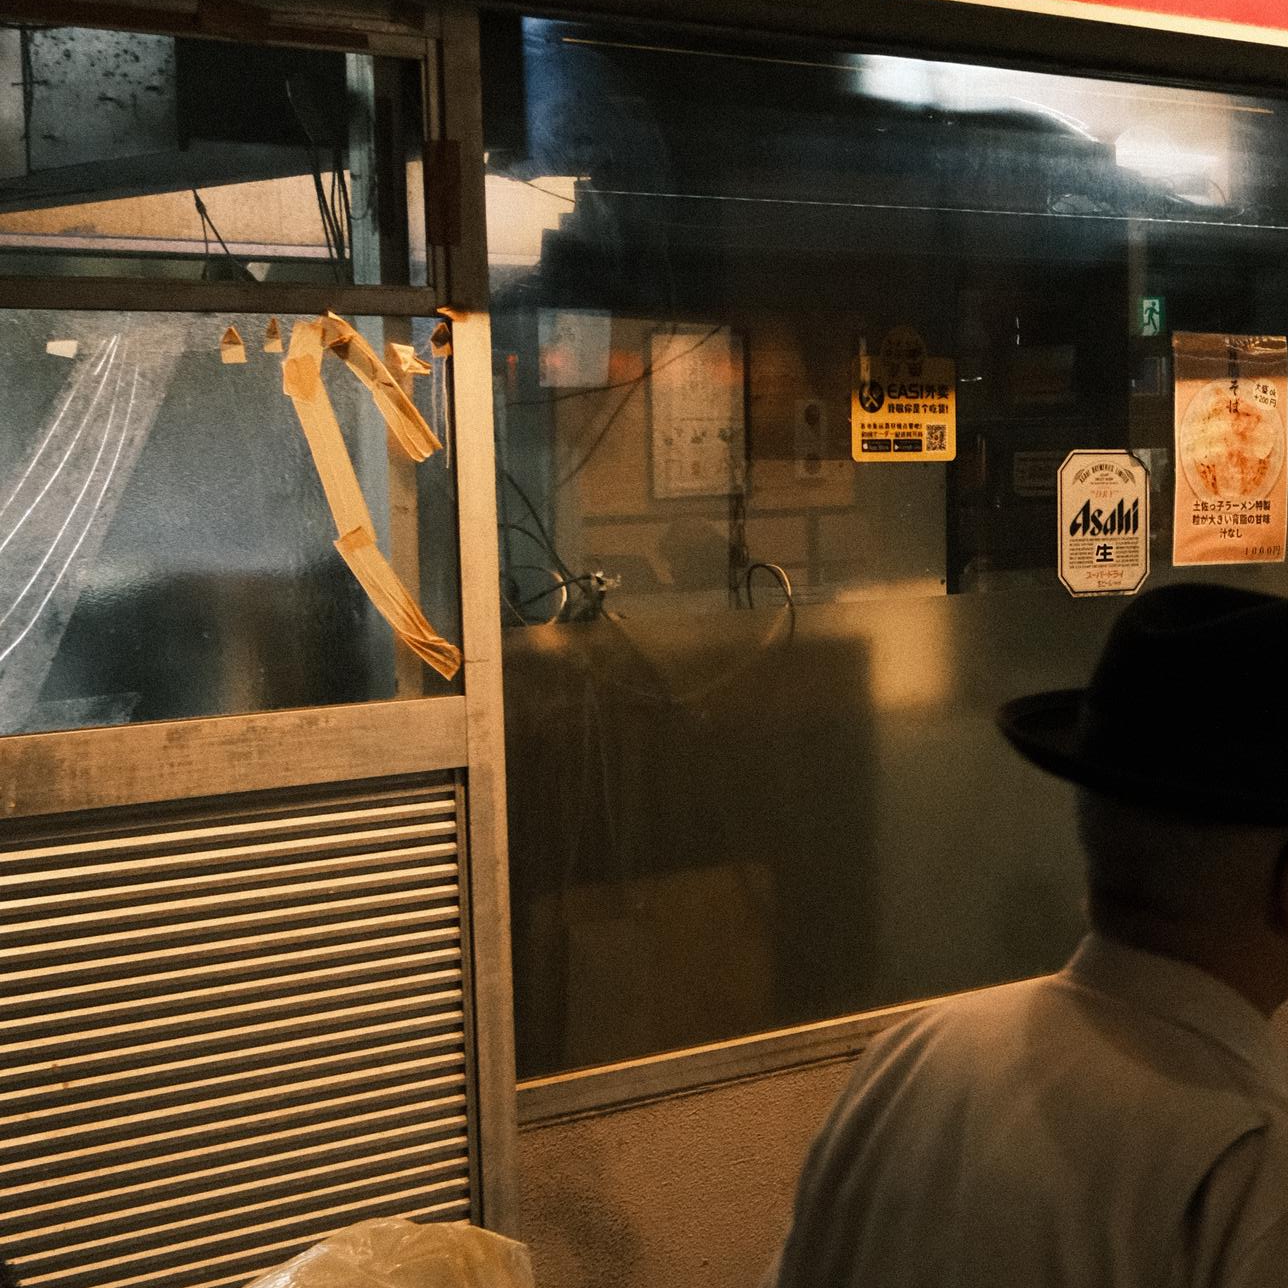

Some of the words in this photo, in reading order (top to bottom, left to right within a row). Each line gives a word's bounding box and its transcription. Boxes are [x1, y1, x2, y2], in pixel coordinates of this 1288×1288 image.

[1192, 500, 1271, 512] 土佐っ子ラーメン特製
[1069, 497, 1139, 537] Asahi
[1219, 528, 1244, 539] 汁なし
[1096, 543, 1114, 563] 生
